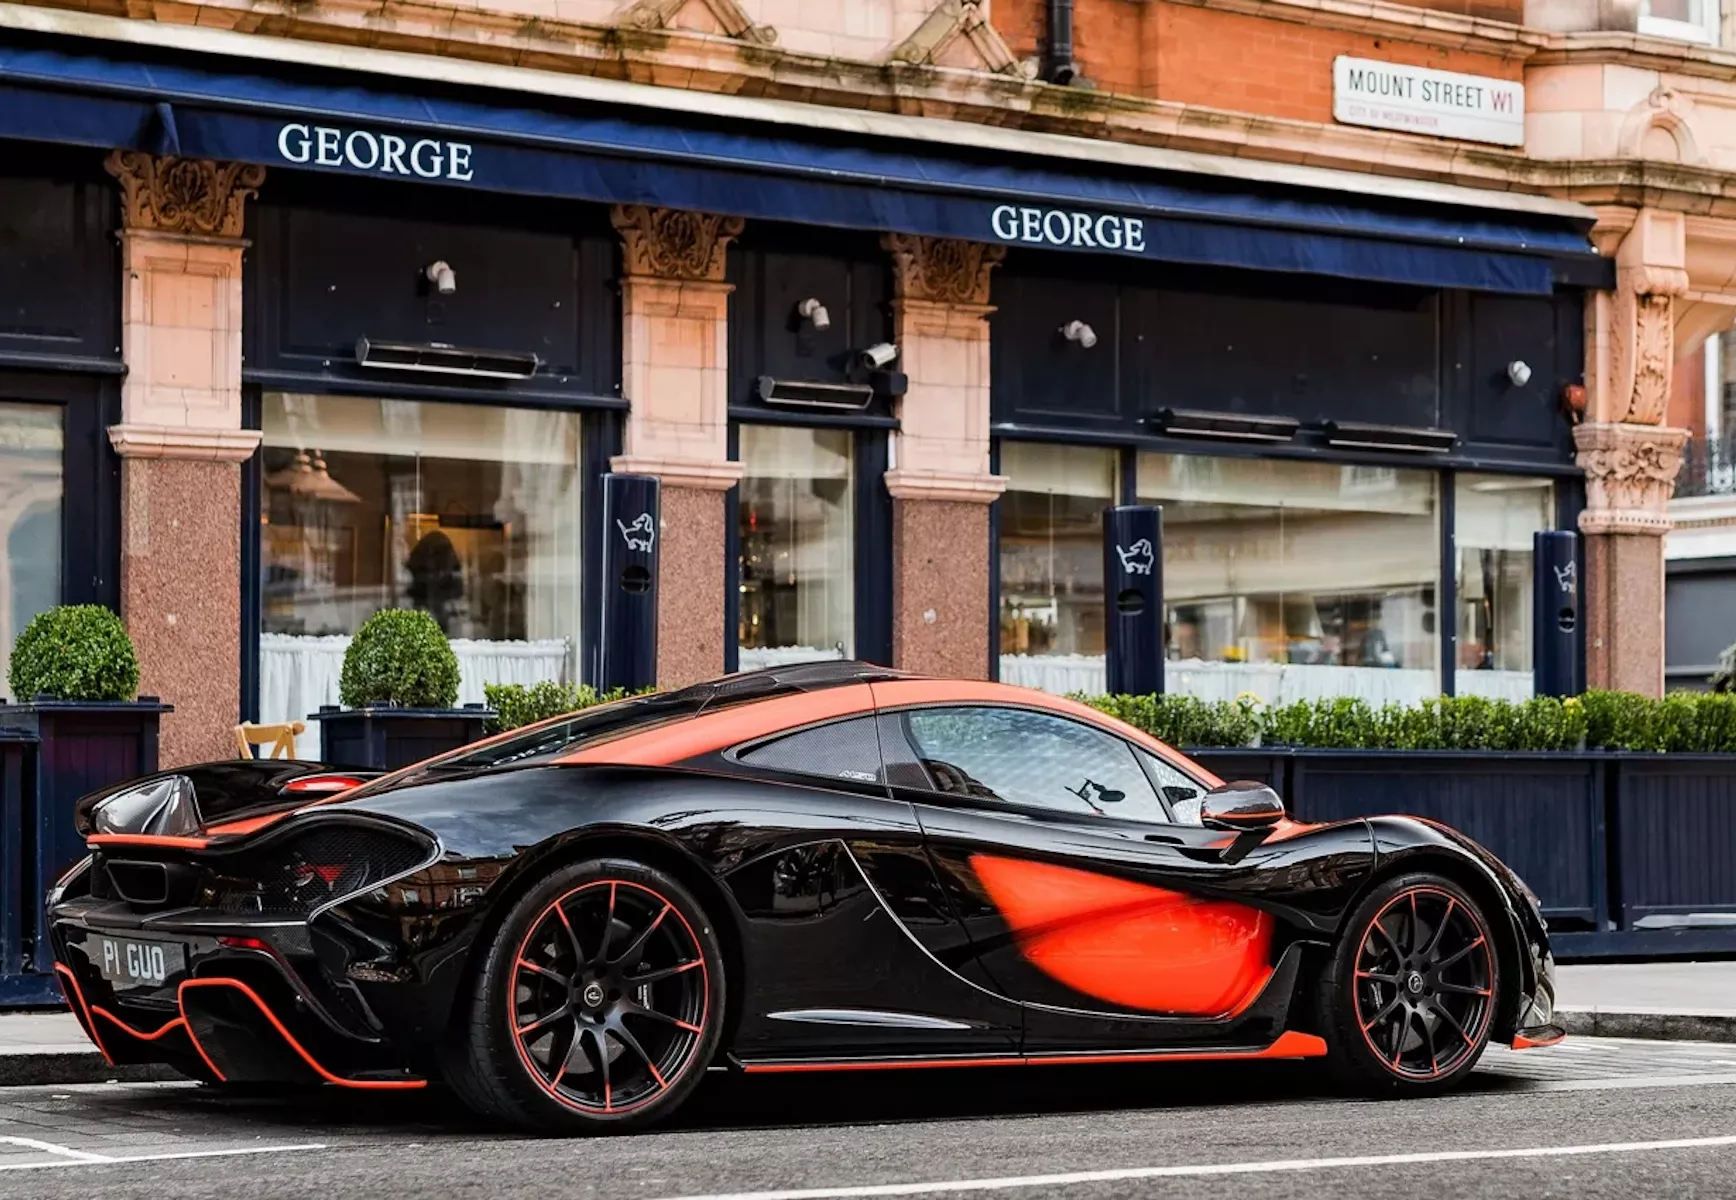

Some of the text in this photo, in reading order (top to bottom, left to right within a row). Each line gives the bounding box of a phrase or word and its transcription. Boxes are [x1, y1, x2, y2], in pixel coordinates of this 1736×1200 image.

[1349, 68, 1514, 114] MOUNT STREET W1
[277, 123, 475, 182] GEORGE
[991, 204, 1146, 253] GEORGE
